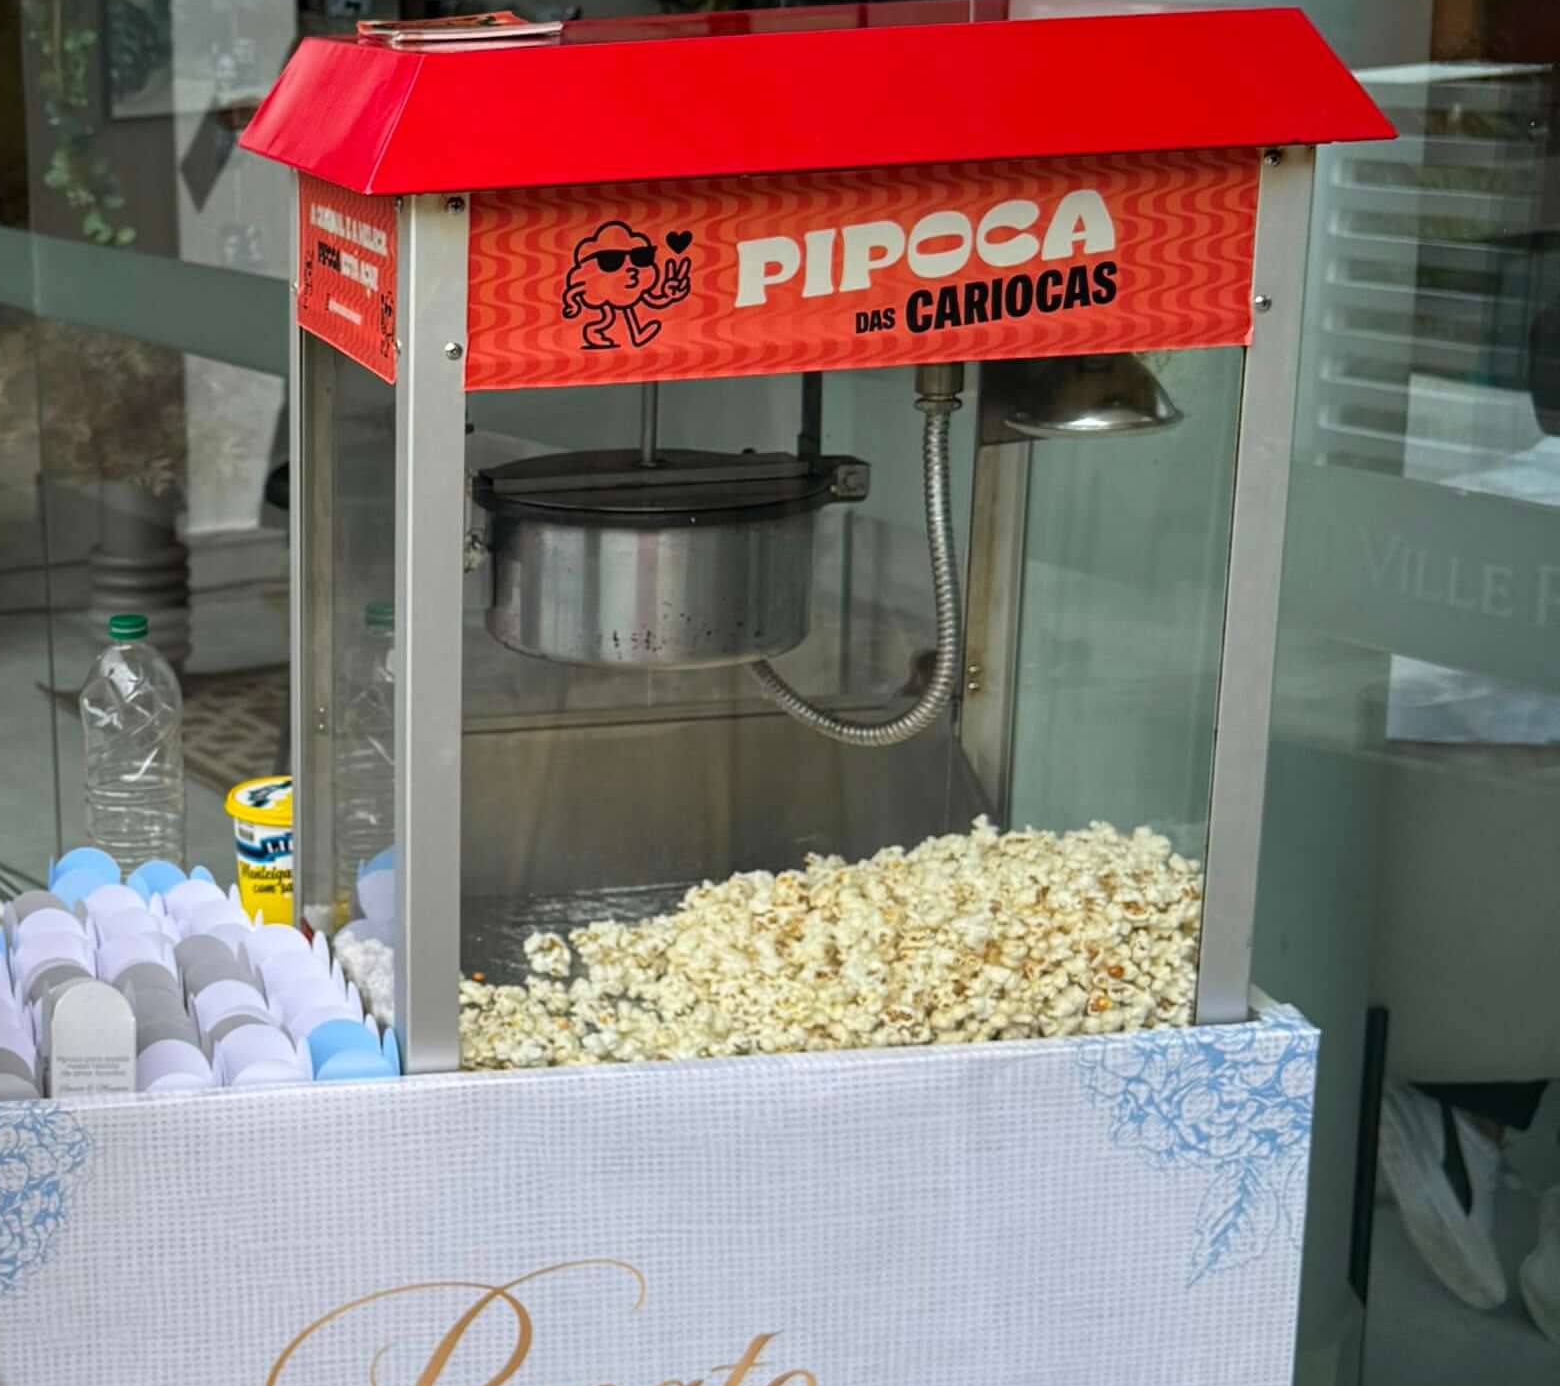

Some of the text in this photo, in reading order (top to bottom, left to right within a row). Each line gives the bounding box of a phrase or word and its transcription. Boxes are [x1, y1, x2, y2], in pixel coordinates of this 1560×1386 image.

[734, 189, 1116, 308] PIPOCA
[855, 261, 1118, 334] DAS CARIOCAS
